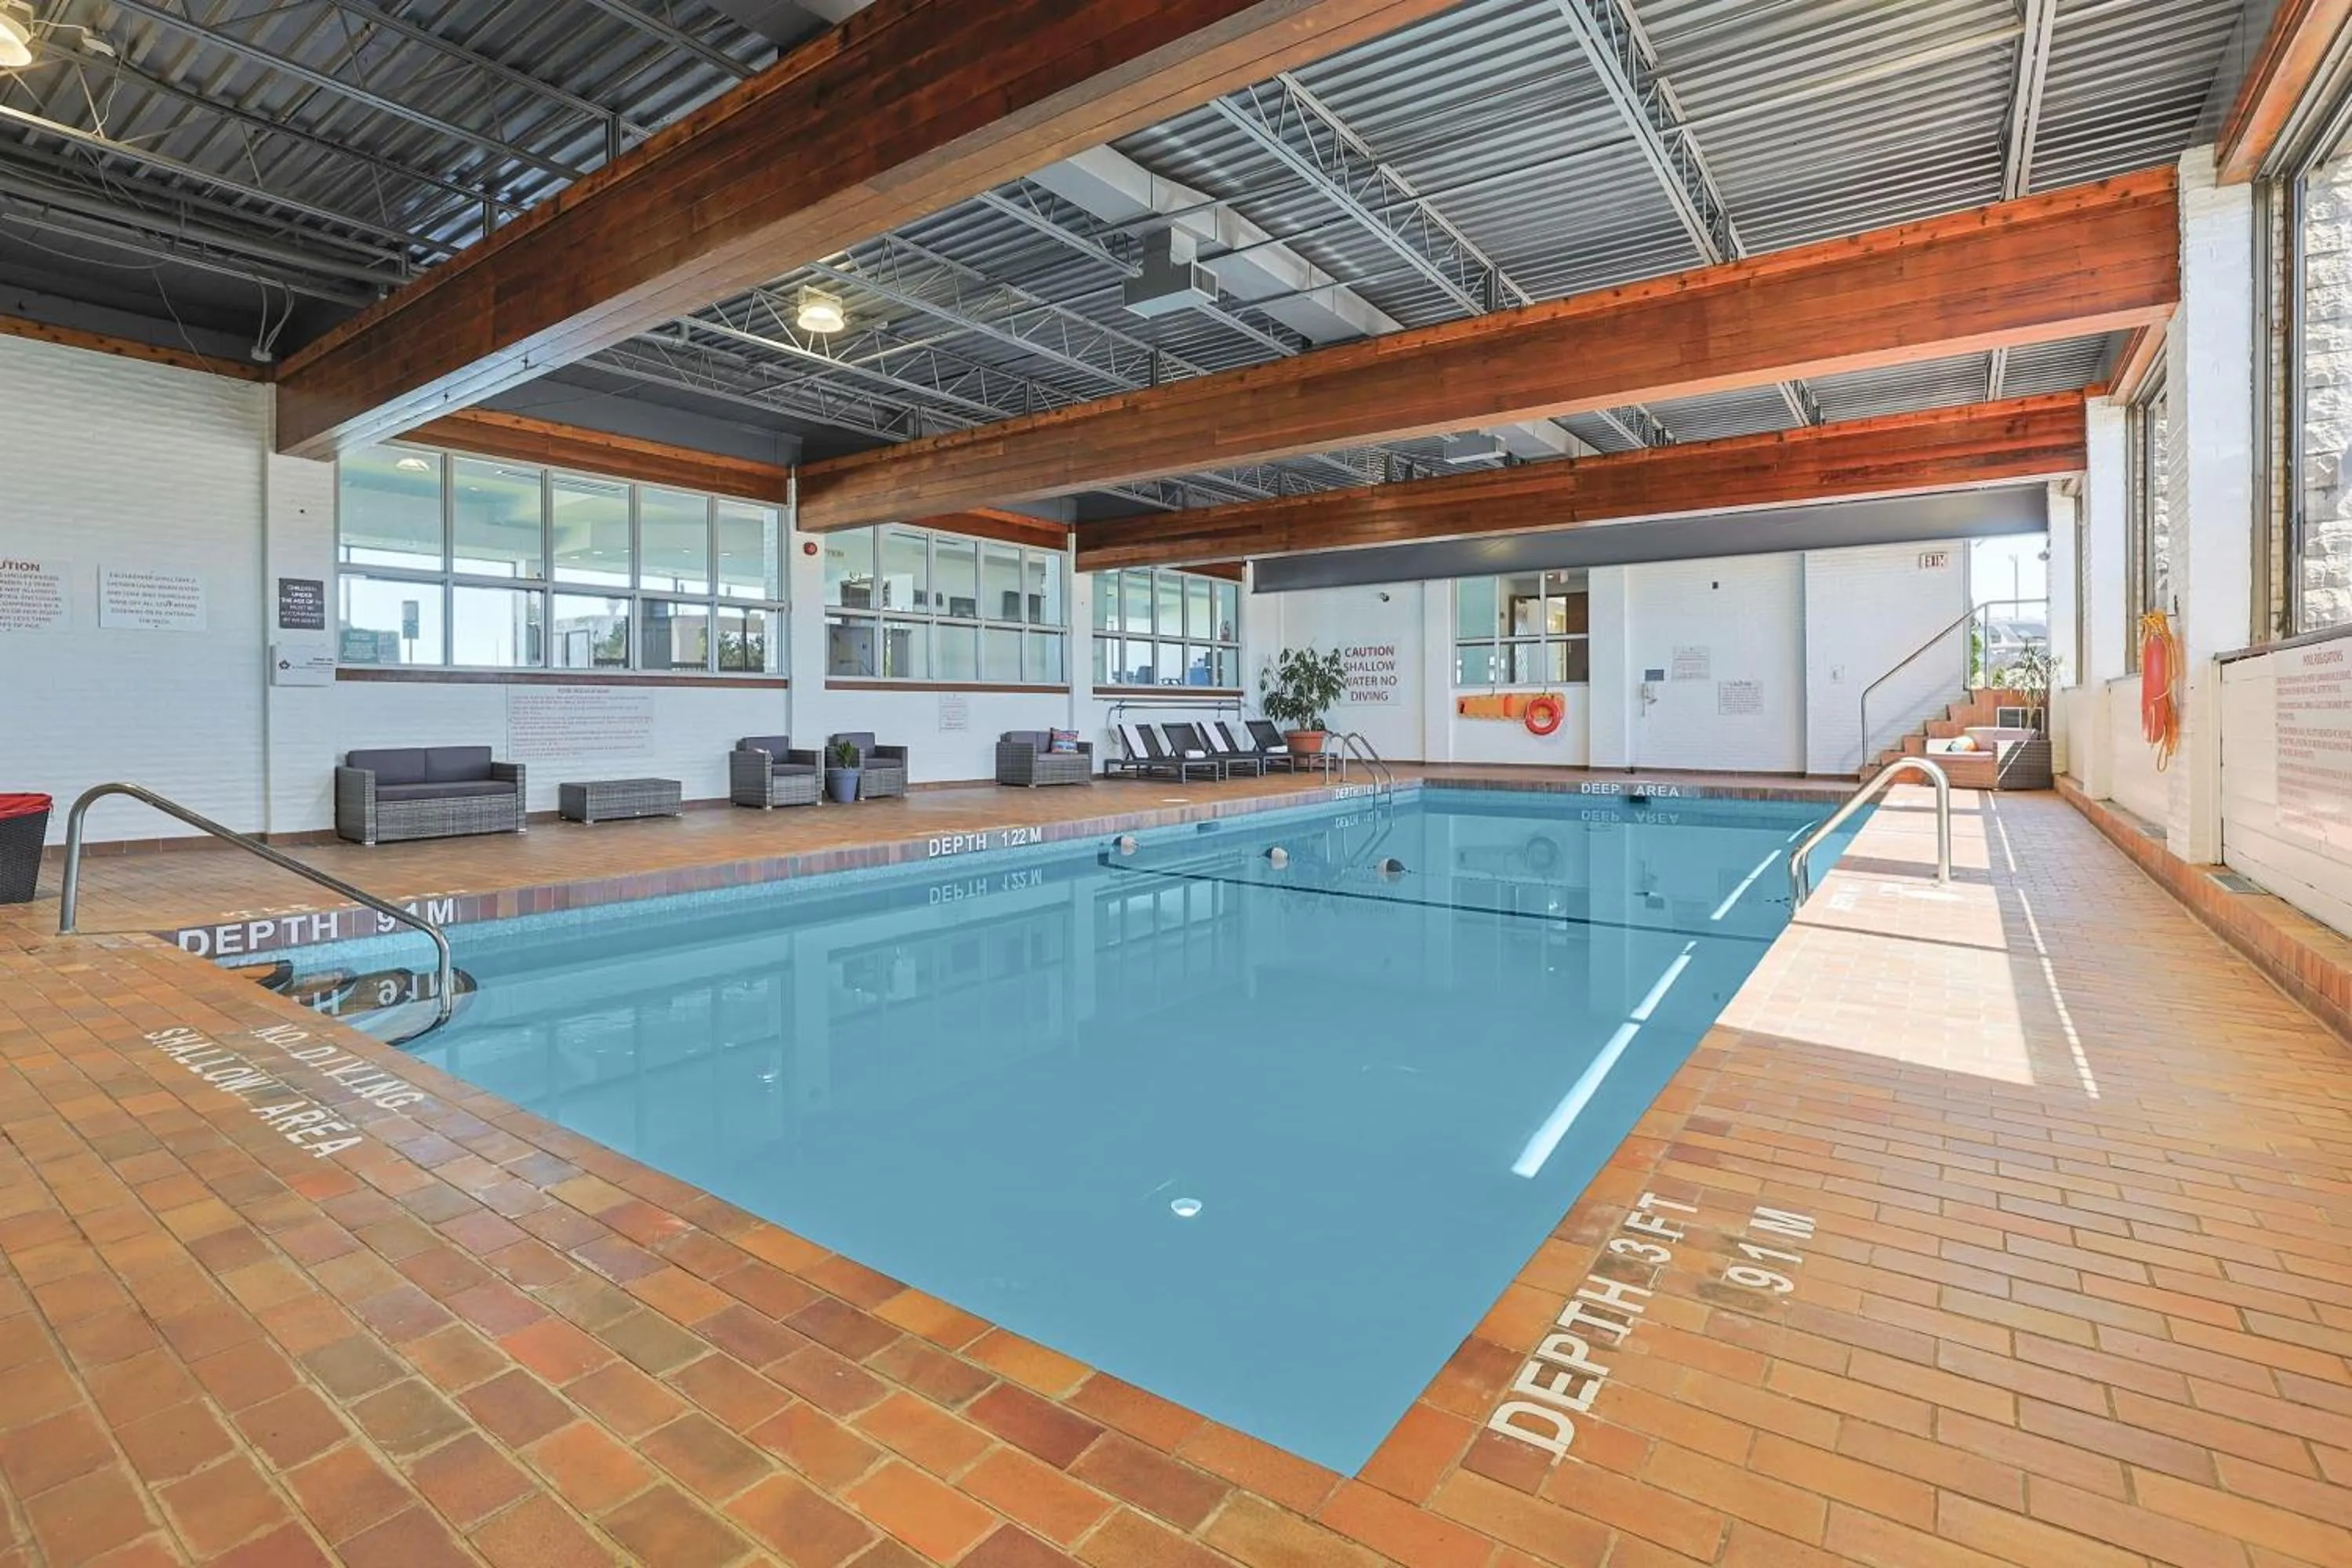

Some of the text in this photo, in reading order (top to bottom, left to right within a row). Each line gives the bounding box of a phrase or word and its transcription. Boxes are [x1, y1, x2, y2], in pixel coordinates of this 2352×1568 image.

[1345, 645, 1395, 657] CAUTION
[1343, 661, 1395, 672] SHALLOW
[1380, 675, 1398, 687] NO
[1351, 691, 1388, 702] DIVING
[1581, 783, 1679, 797] DEEP AREA
[929, 833, 987, 857] DEPTH
[178, 912, 338, 957] DEPTH
[250, 1023, 424, 1110] NO DIVING
[144, 1027, 362, 1158] SHALLOW AREA
[1488, 1274, 1653, 1465] DEPTH
